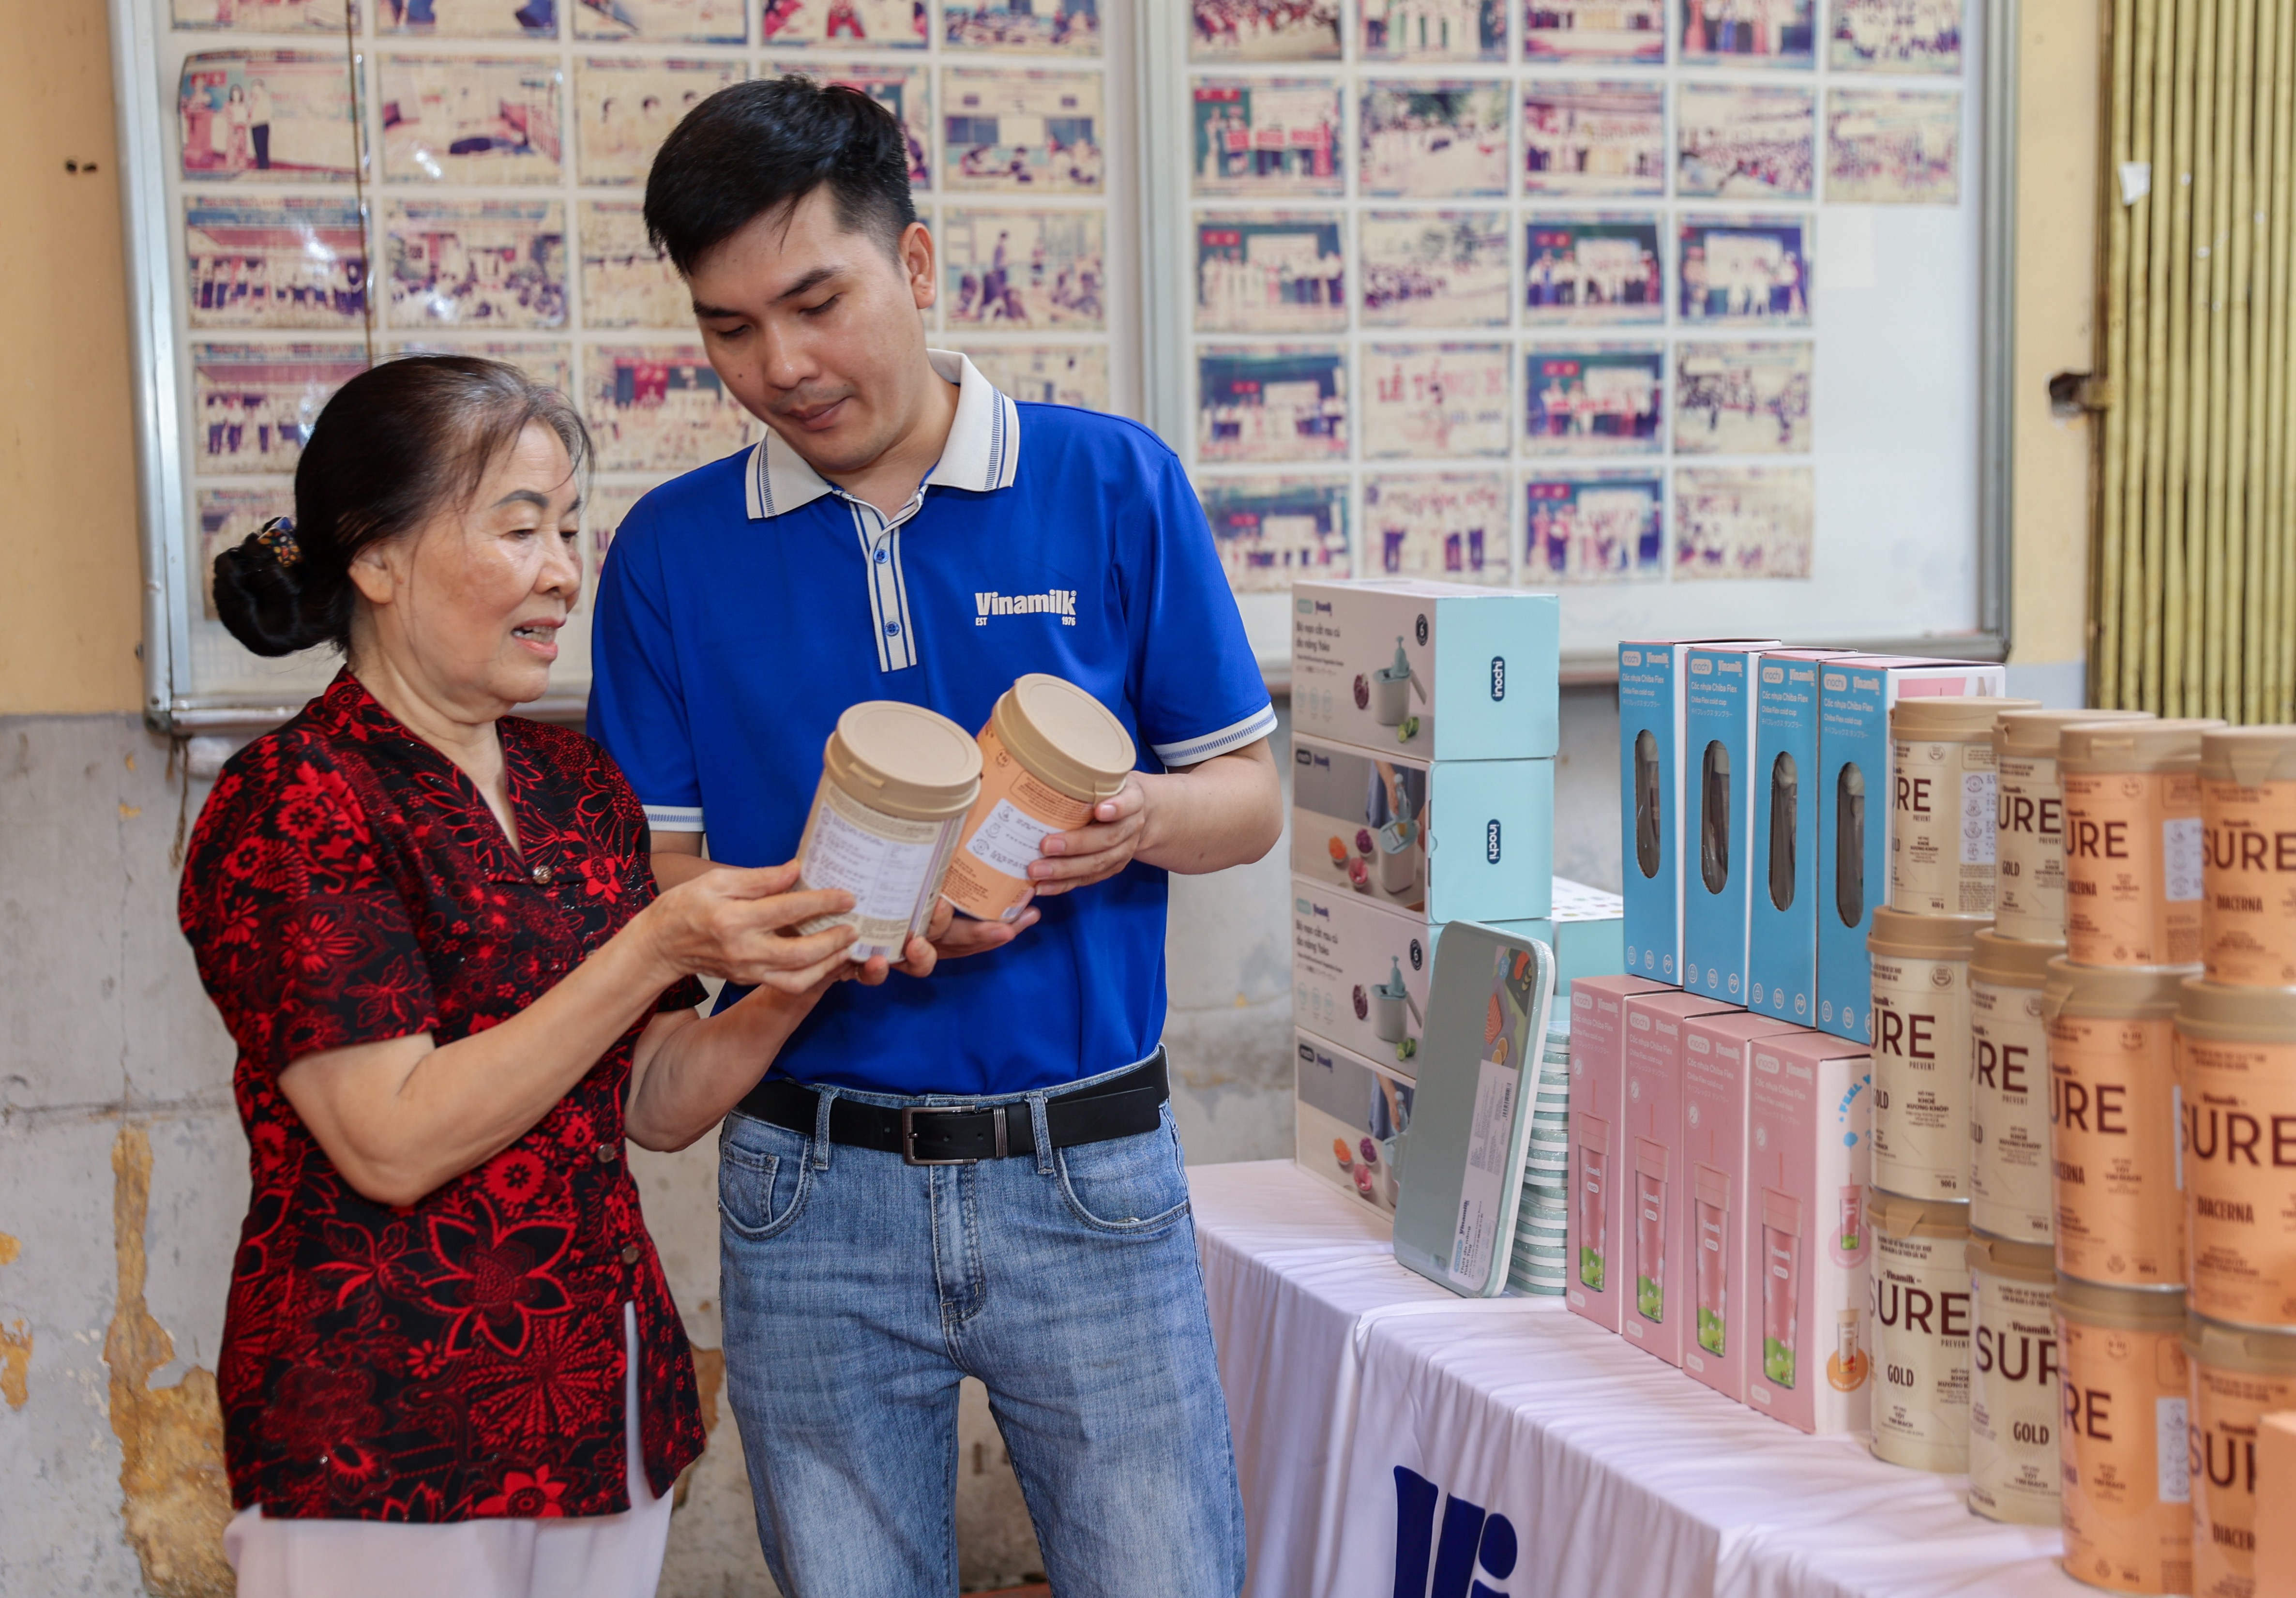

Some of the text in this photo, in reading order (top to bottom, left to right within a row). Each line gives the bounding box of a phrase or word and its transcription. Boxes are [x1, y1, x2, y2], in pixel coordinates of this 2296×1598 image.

[975, 589, 1076, 615] Vinamilk
[975, 617, 1075, 626] EST 1976
[1646, 652, 1669, 663] Vinamilk
[1718, 660, 1742, 672] Vinamilk
[1493, 661, 1503, 697] inochi
[1789, 669, 1814, 681] Vinamilk
[1853, 676, 1879, 690] Vinamilk
[1897, 776, 1931, 812] RE
[1913, 814, 1931, 822] PREVENT
[1998, 794, 2062, 834] URE
[1489, 824, 1499, 859] inochi
[2066, 821, 2129, 859] URE
[2003, 860, 2020, 876] GOLD
[2217, 894, 2263, 913] DIACERNA
[1871, 1008, 1935, 1059] URE
[1910, 1061, 1935, 1071] PREVENT
[1972, 1036, 2028, 1094] RE
[1874, 1088, 1888, 1110] OLD
[2002, 1094, 2027, 1105] PREVENT
[2051, 1077, 2127, 1135] URE
[1941, 1179, 1956, 1189] 900 g
[1459, 1200, 1468, 1235] Vinamilk
[2198, 1195, 2254, 1224] DIACERNA
[1887, 1269, 1915, 1284] Vinamilk
[1870, 1273, 1970, 1337] SURE
[2012, 1321, 2051, 1336] Vinamilk
[1941, 1339, 1970, 1348] PREVENT
[1977, 1325, 2058, 1386] SUR
[1888, 1364, 1914, 1387] GOLD
[2064, 1380, 2113, 1442] RE
[2013, 1421, 2050, 1445] GOLD
[2190, 1426, 2256, 1494] SU
[2213, 1522, 2255, 1552] DIACER
